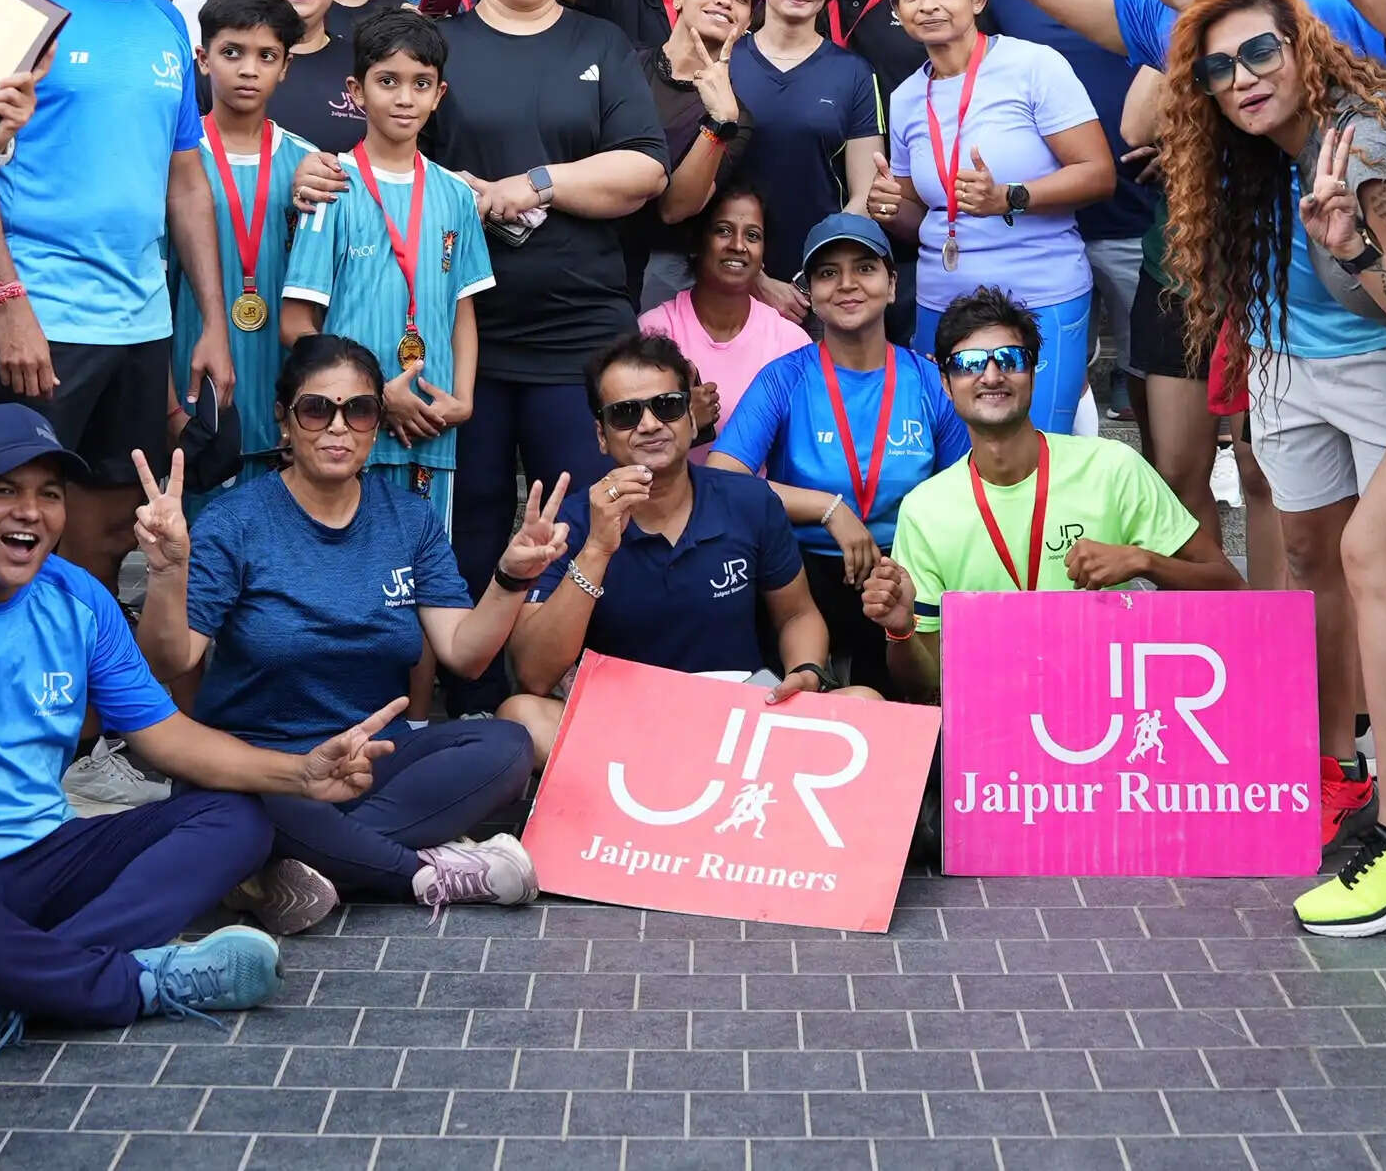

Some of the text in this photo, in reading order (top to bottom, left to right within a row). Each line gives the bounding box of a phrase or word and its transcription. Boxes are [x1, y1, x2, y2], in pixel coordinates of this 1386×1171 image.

[887, 419, 924, 447] JR
[710, 558, 748, 589] JR
[32, 671, 73, 705] JR
[1030, 642, 1230, 765] JR
[608, 709, 869, 849] JR
[953, 771, 1310, 825] Jaipur Runners
[580, 835, 837, 892] Jaipur Runners
